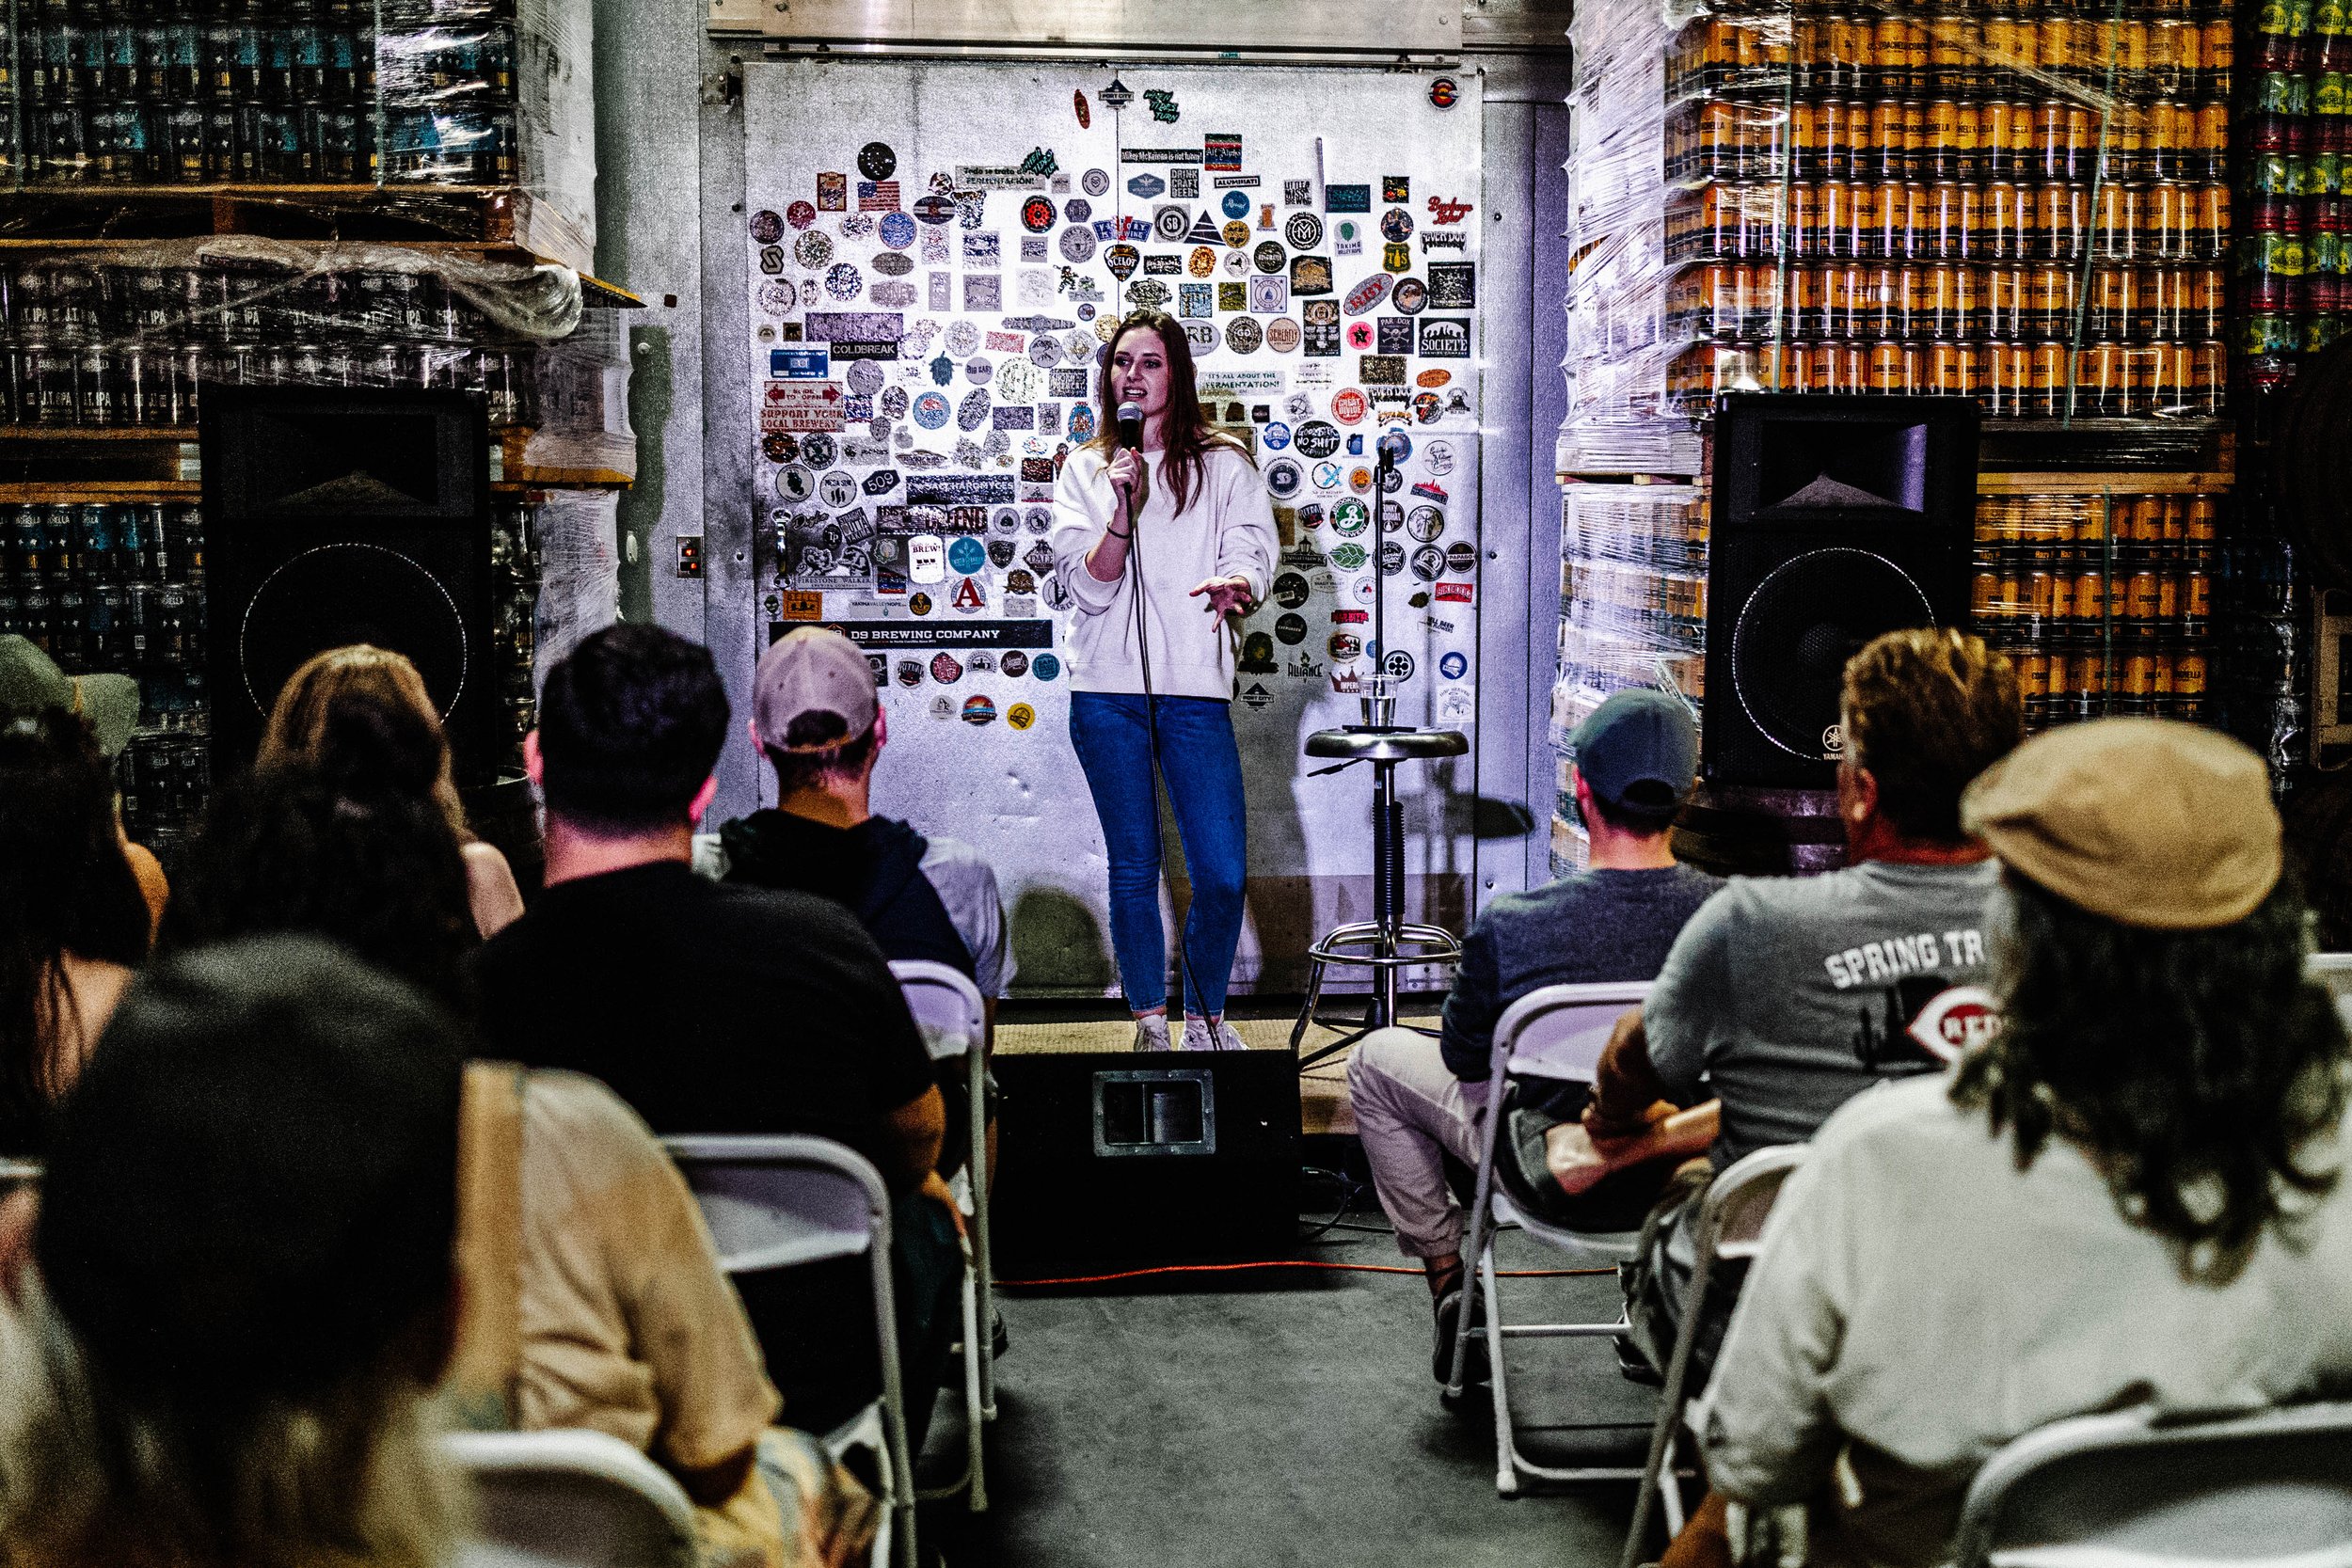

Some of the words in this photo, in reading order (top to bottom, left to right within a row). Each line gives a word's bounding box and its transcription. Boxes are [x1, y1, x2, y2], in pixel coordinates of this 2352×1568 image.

[1170, 169, 1198, 179] DRINK
[1170, 179, 1198, 188] CRAFT
[1171, 188, 1194, 198] BEER
[1167, 217, 1178, 230] SB
[1107, 257, 1136, 267] OCELOT
[833, 344, 896, 355] COLDBREAK
[1422, 339, 1468, 352] SOCIETE
[761, 410, 810, 419] SUPPORT
[814, 410, 845, 419] YOUR
[761, 420, 789, 428] LOCAL
[793, 420, 836, 428] BREWERY
[1296, 437, 1310, 447] NO
[1311, 437, 1340, 450] SHIT
[867, 472, 895, 492] 509
[1331, 497, 1365, 515] BROOKLYN
[848, 527, 872, 543] YAKIMA
[1335, 523, 1368, 538] BREWERY
[952, 577, 986, 608] A
[850, 630, 868, 640] D9
[871, 630, 932, 640] BREWING
[935, 629, 1000, 639] COMPANY
[1287, 663, 1324, 677] ALLIANCE
[1823, 752, 1844, 761] YAMAH
[1824, 933, 1941, 989] SPRING
[1943, 928, 1986, 967] TR
